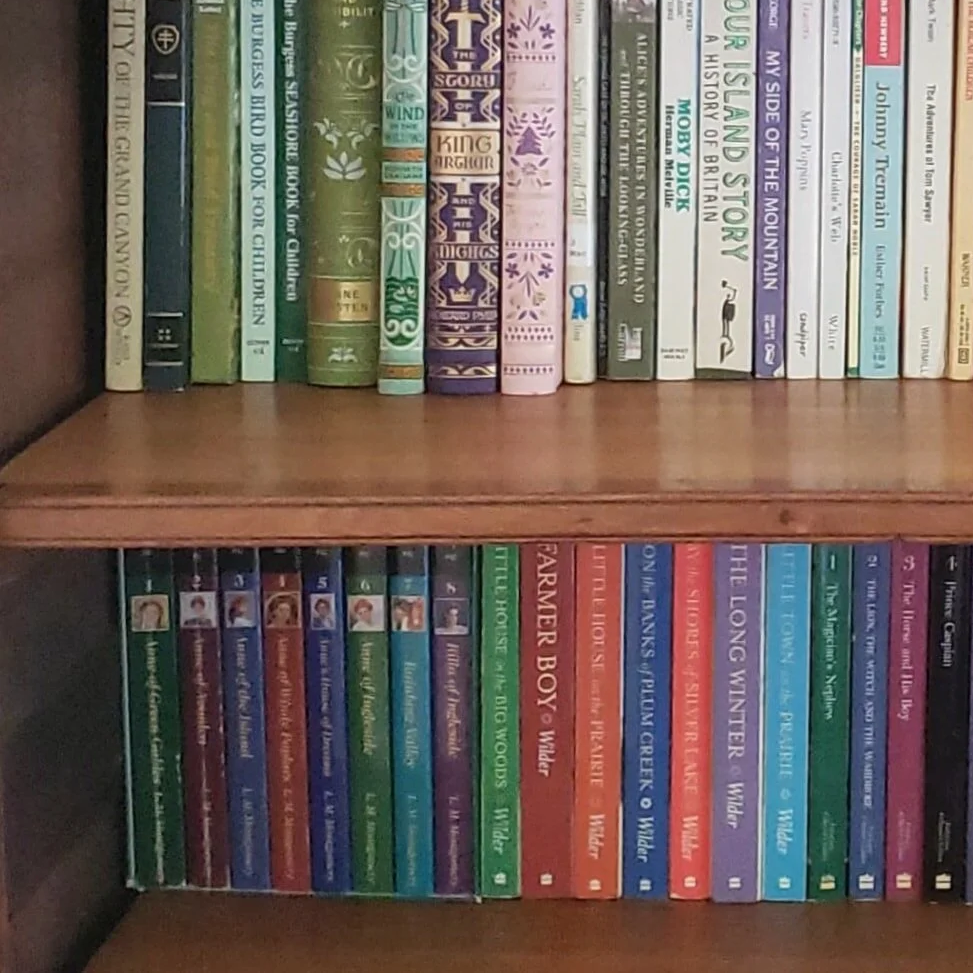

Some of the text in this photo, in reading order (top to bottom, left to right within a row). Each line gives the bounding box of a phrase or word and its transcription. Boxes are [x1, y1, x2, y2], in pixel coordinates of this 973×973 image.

[114, 62, 130, 85] OF
[251, 13, 264, 89] BURGESS
[766, 51, 780, 75] MY
[880, 16, 888, 58] NEWBERY
[114, 91, 131, 131] THE
[250, 93, 266, 137] BIRD
[703, 35, 718, 222] A HISTORY OF BRITAIN
[724, 62, 750, 163] ISLAND
[765, 129, 779, 150] OF
[766, 80, 780, 122] SIDE
[114, 137, 130, 206] GRAND
[251, 143, 265, 190] BOOK
[633, 32, 647, 303] ALICE'S ADVENTURES IN WONDERLAND
[676, 99, 690, 211] MOBY DICK
[765, 157, 779, 192] THE
[830, 152, 842, 211] Charlotte's
[252, 196, 264, 229] FOR
[721, 173, 750, 262] STORY
[764, 198, 779, 290] MOUNTAIN
[114, 213, 130, 298] CANYON
[252, 234, 266, 325] CHILDREN
[822, 584, 837, 719] The Magician's Nephew
[898, 582, 914, 720] The Horse and His Boy
[941, 581, 956, 667] Prince Caspian
[493, 599, 509, 854] HOUSE BIG WOODS Wilder
[537, 655, 557, 777] BOY Wilder
[727, 596, 746, 828] LONG WINTER Wilder
